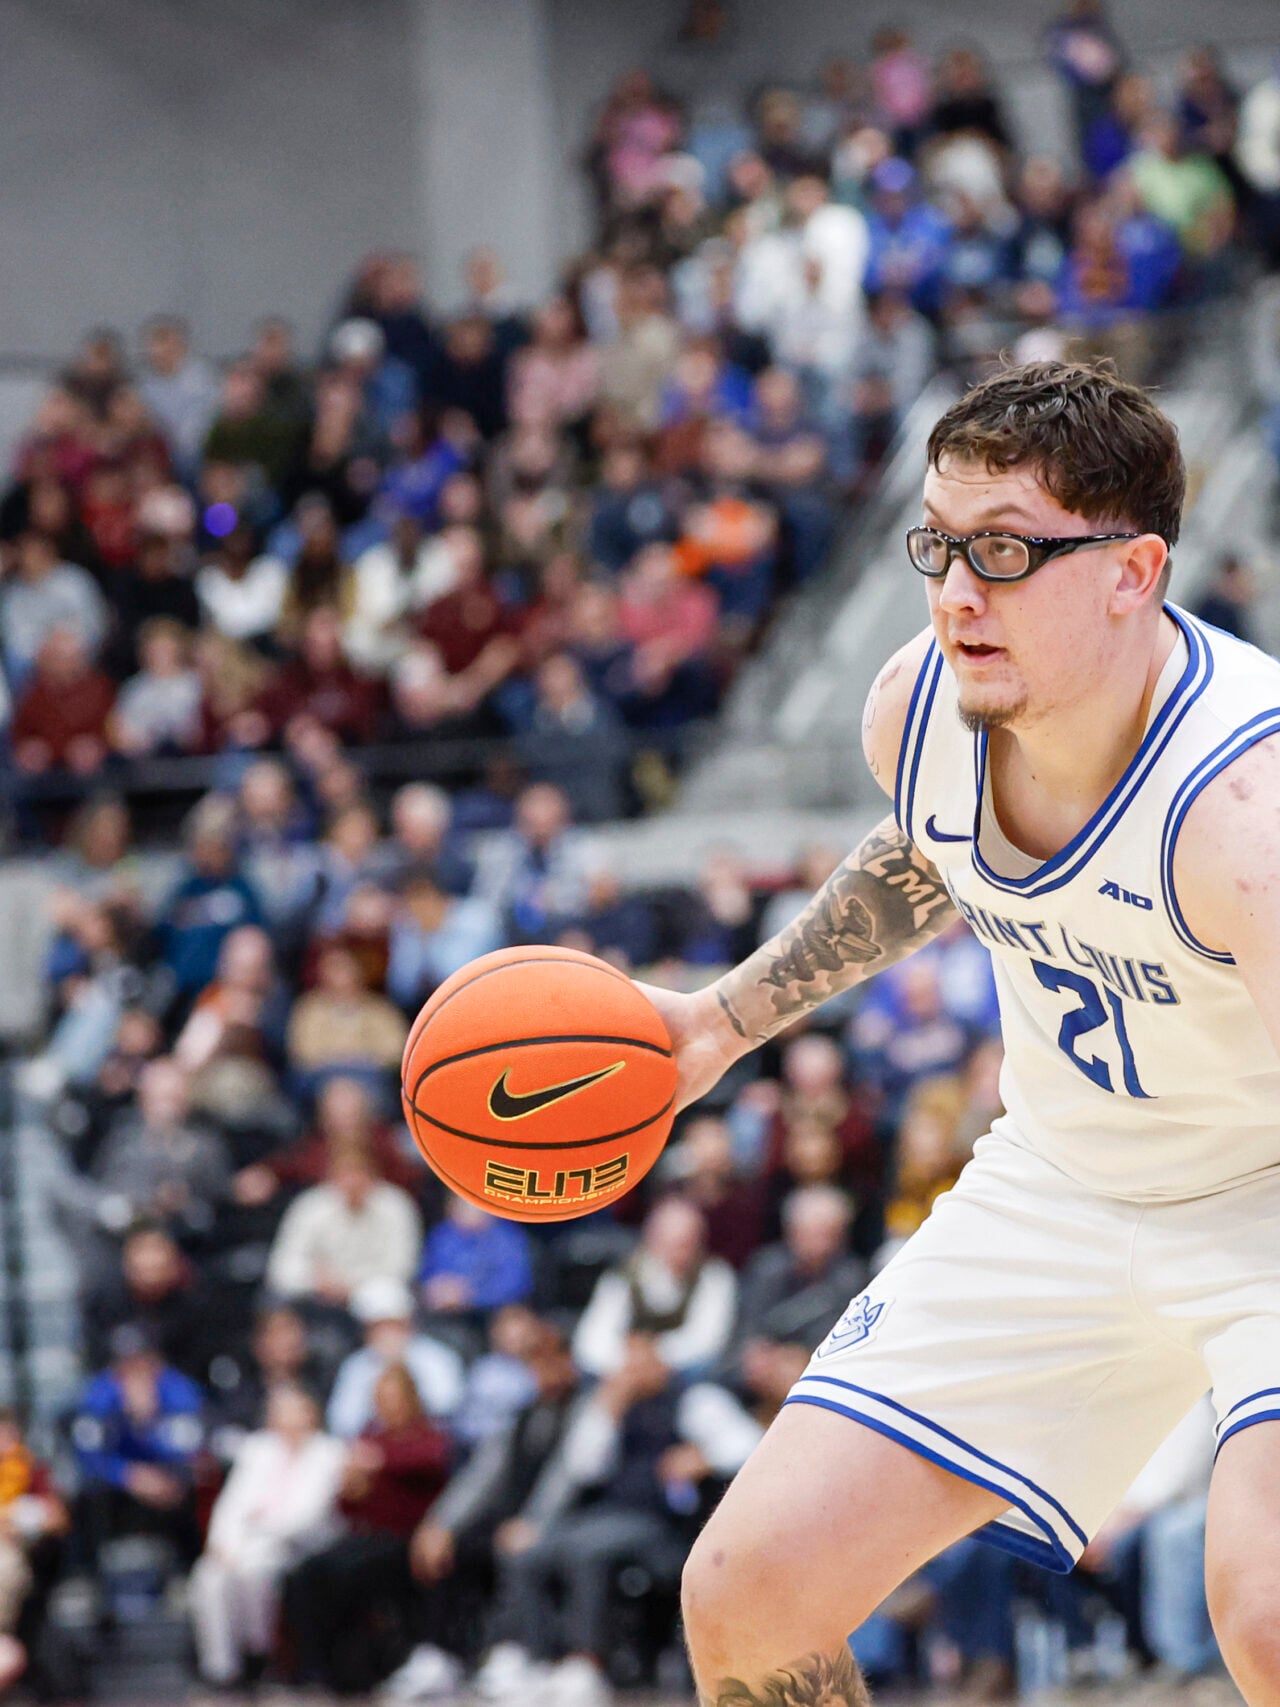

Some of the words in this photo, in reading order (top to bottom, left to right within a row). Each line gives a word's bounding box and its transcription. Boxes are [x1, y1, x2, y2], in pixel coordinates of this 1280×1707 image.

[948, 872, 1057, 958] AINT
[1097, 878, 1153, 911] A10
[1029, 957, 1158, 1099] 21
[484, 1180, 627, 1206] CHAMPIONSHIP
[485, 1152, 630, 1198] ELITE
